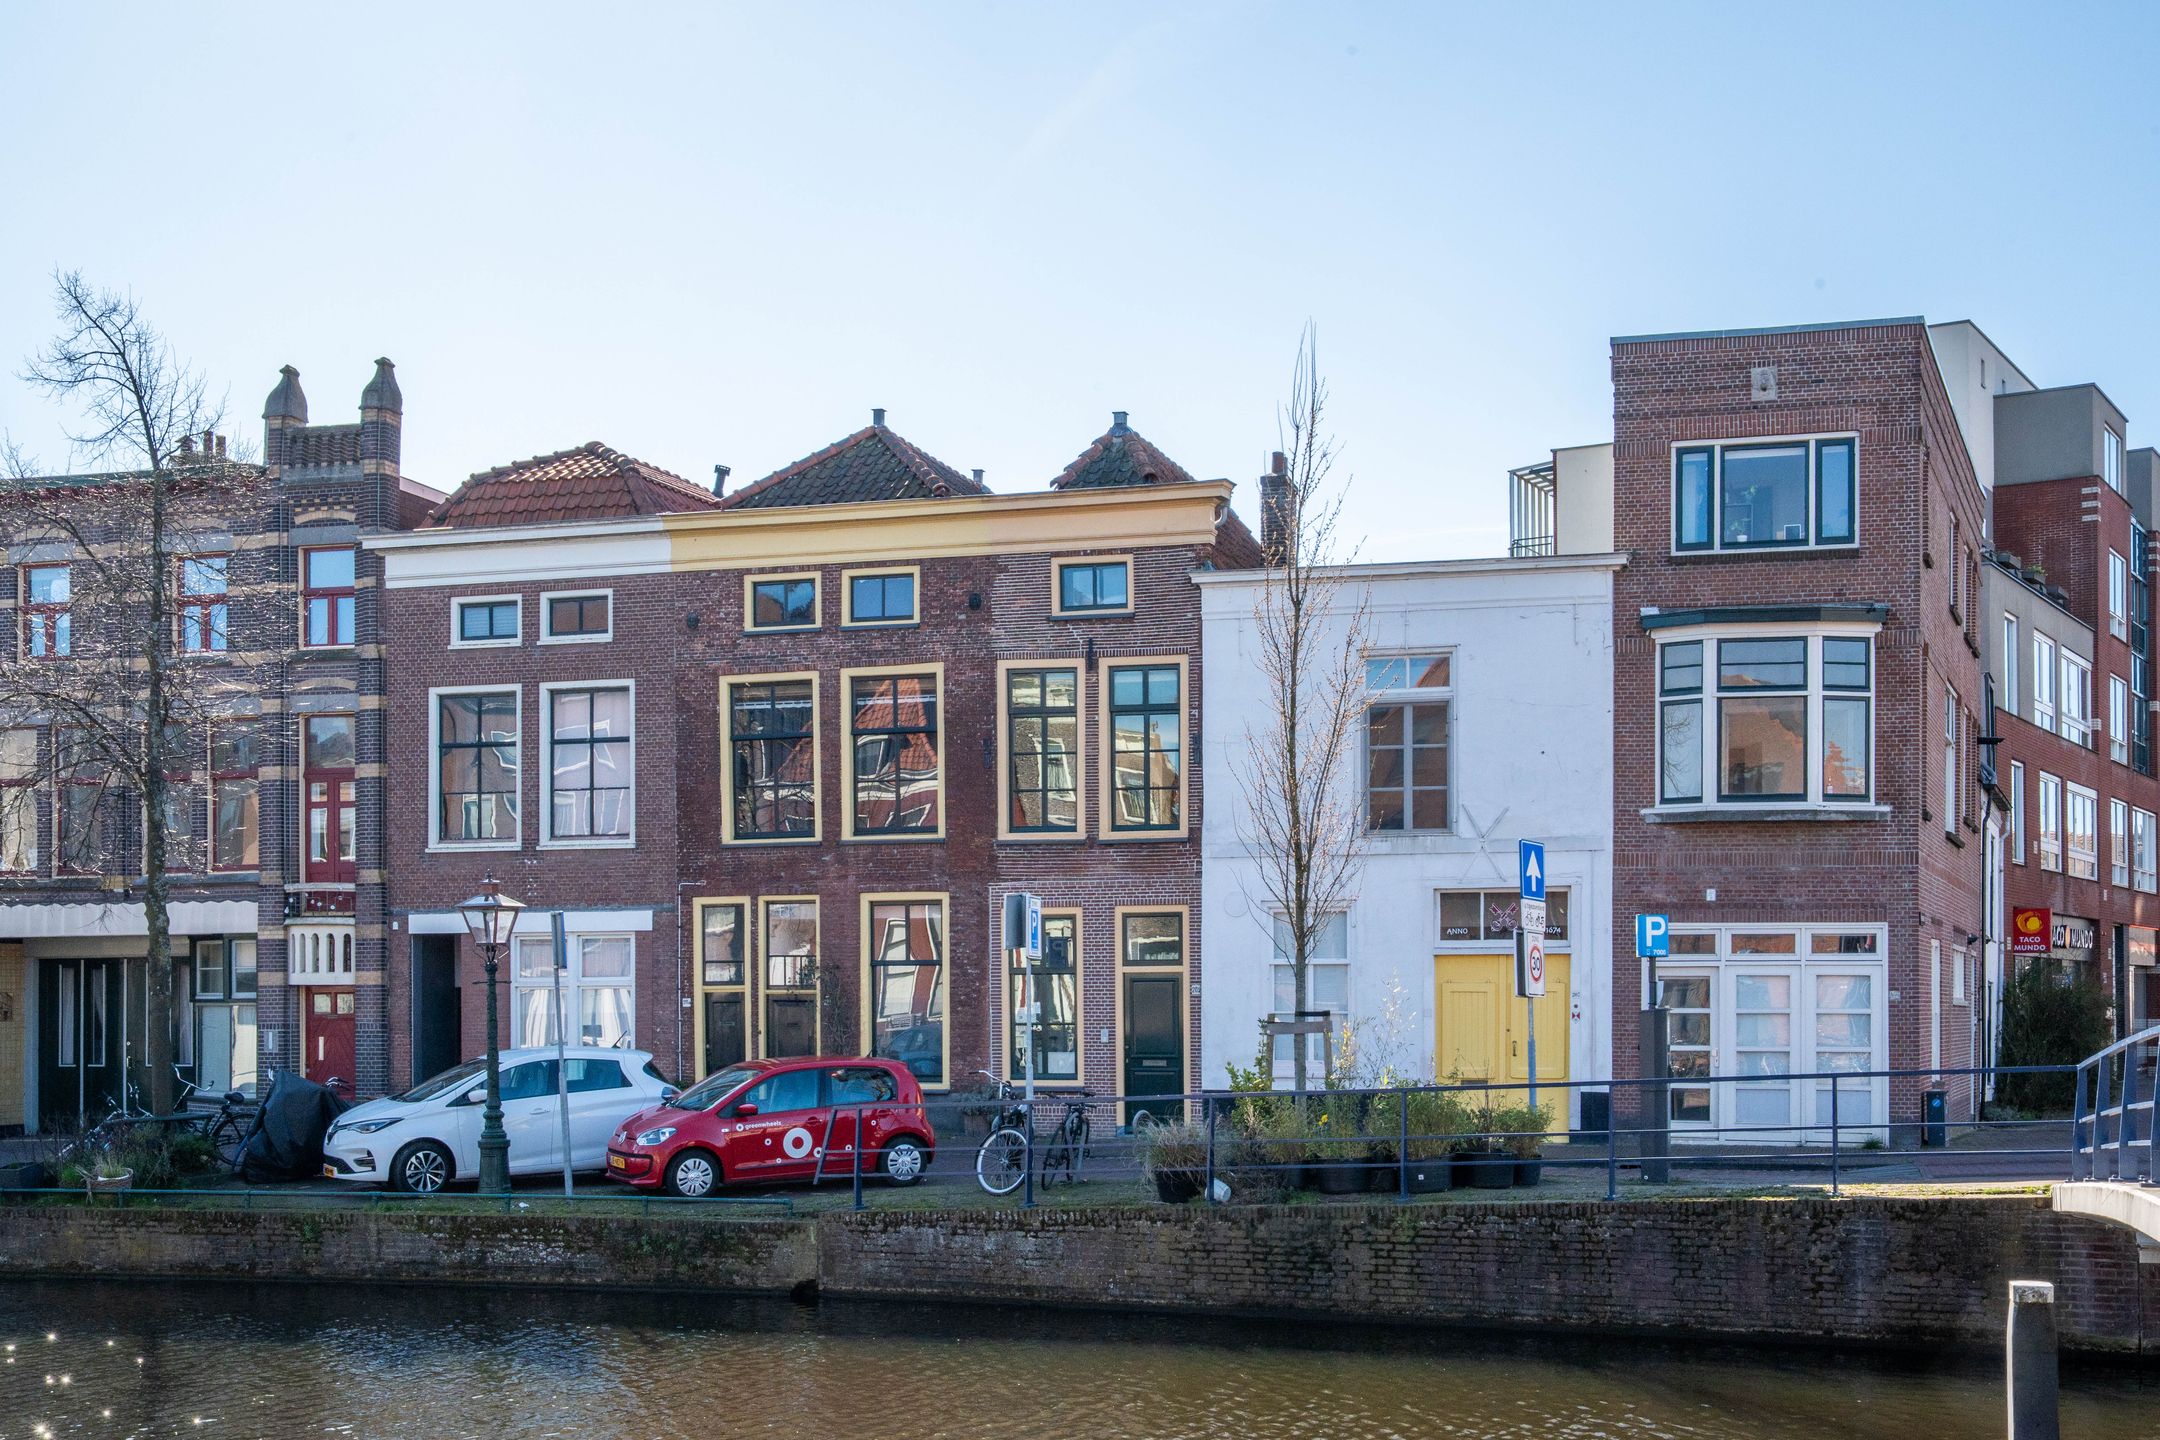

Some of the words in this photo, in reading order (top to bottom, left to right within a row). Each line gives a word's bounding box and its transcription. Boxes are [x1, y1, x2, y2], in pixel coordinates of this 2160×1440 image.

[1032, 913, 1037, 934] P
[1646, 916, 1666, 947] P
[2052, 926, 2065, 946] ACO
[2071, 927, 2093, 949] MUNDO
[1532, 956, 1540, 971] 30
[744, 1120, 782, 1130] greenwheels
